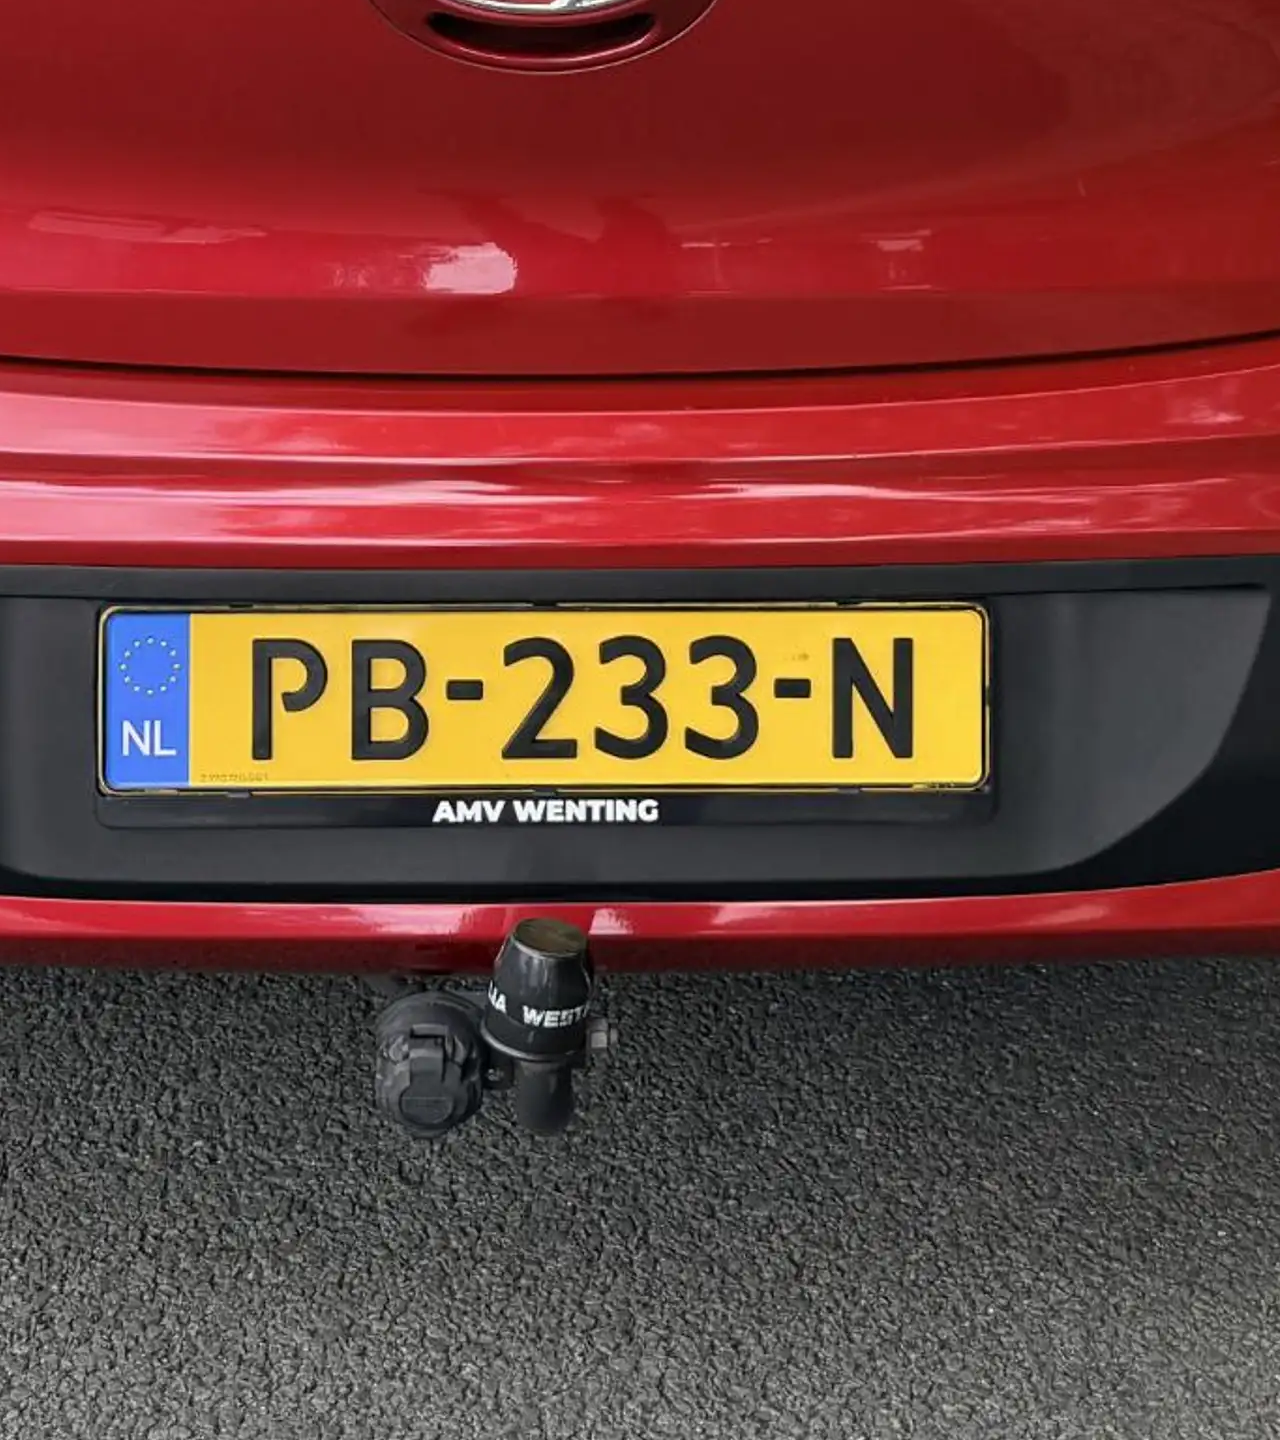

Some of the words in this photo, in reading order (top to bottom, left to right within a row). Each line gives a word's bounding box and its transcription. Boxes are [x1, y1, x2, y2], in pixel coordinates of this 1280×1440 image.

[252, 635, 913, 761] PB-233-N
[122, 720, 176, 756] NL
[432, 800, 506, 822] AMV
[513, 799, 659, 822] WENTING
